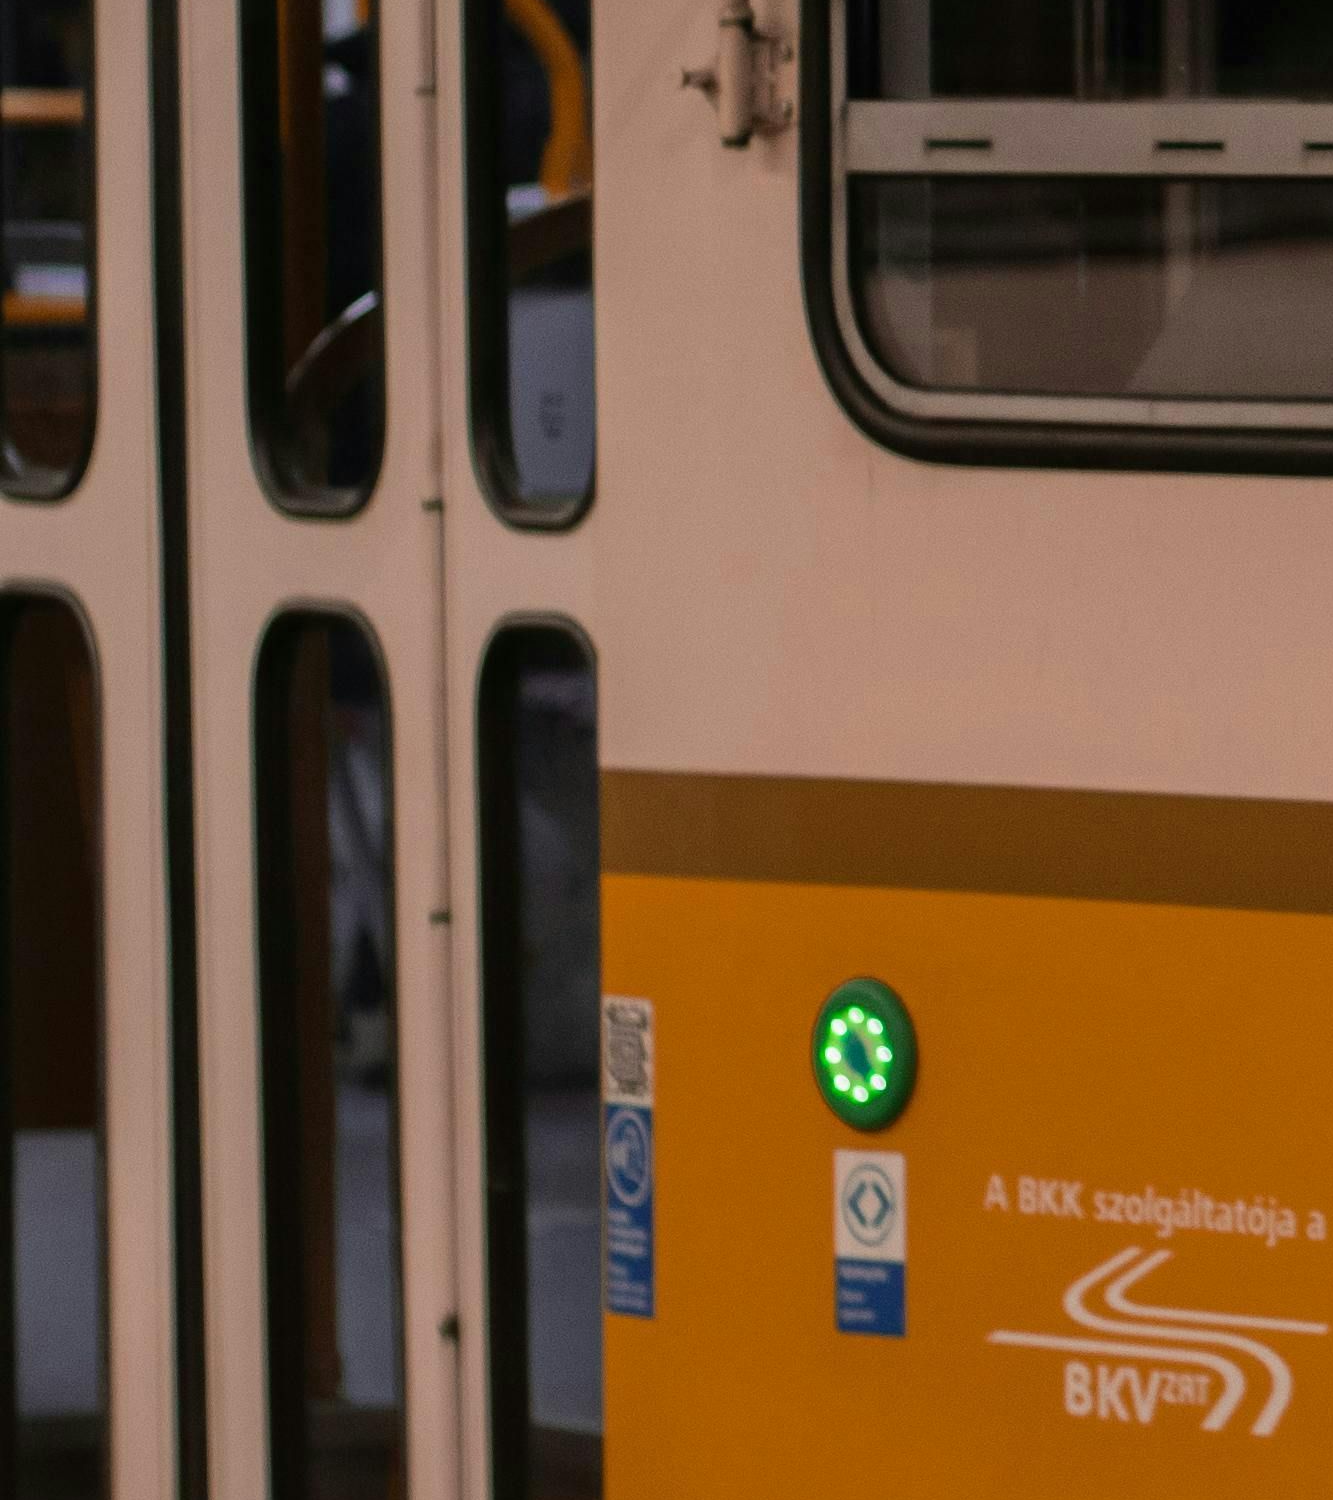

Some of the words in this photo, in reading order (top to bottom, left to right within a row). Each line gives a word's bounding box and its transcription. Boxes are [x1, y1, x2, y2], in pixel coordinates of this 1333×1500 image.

[983, 1173, 1009, 1212] A
[1016, 1174, 1086, 1220] BKK
[1093, 1182, 1298, 1251] szolgáltatója
[1304, 1208, 1328, 1242] a
